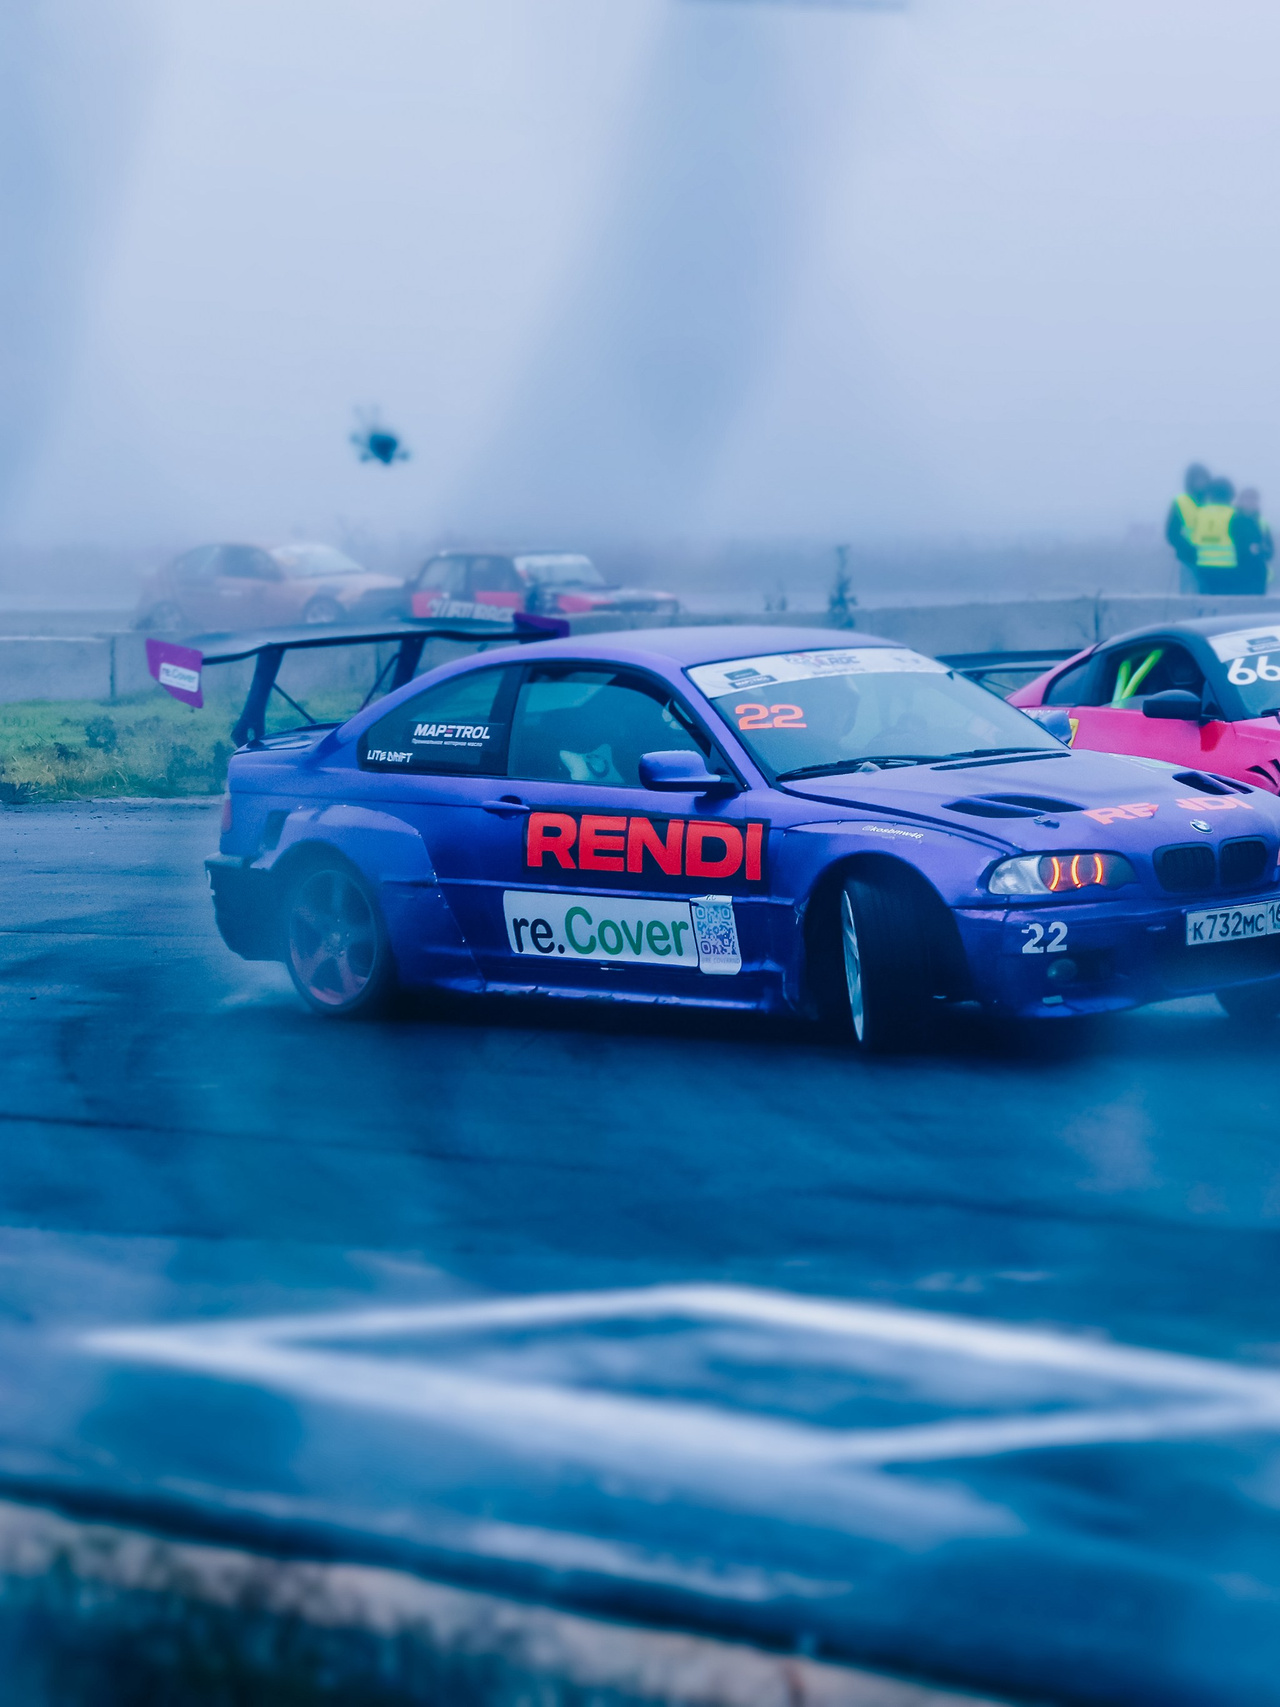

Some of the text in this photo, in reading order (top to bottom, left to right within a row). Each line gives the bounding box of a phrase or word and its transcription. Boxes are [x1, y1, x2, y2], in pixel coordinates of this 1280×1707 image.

[413, 723, 491, 740] MAPETROL
[734, 703, 808, 730] 22
[366, 749, 387, 762] LITE
[526, 812, 763, 881] RENDI
[512, 906, 689, 957] re.Cover
[1021, 921, 1068, 954] 22
